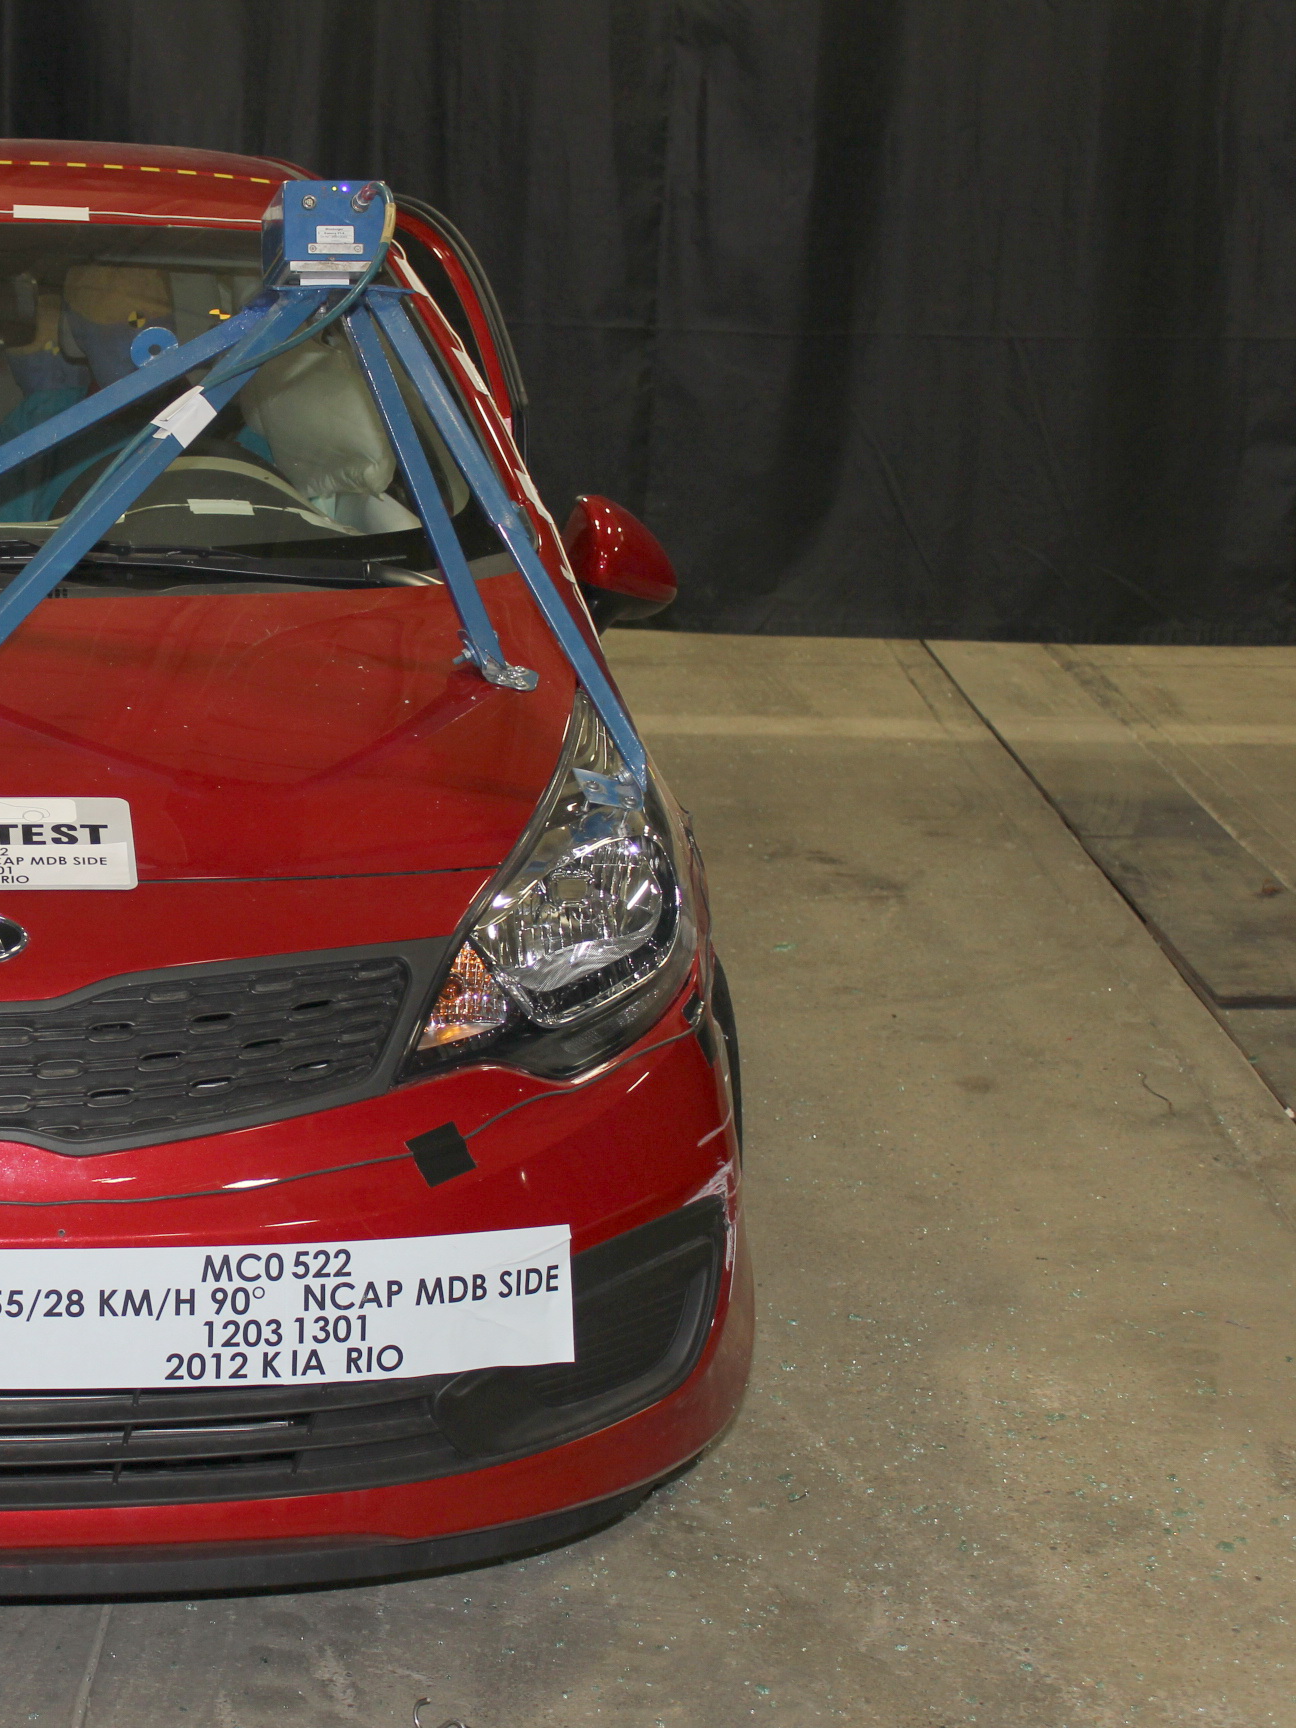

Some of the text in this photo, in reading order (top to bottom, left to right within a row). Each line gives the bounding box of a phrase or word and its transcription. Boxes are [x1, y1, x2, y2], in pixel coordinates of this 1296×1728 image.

[30, 856, 68, 866] MDB
[73, 856, 108, 866] SIDE
[1, 875, 30, 884] RIO
[99, 1288, 196, 1321] KM/H
[210, 1286, 266, 1316] 90°
[303, 1280, 403, 1312] NCAP
[415, 1273, 489, 1306] MDB
[498, 1264, 559, 1299] SIDE
[164, 1351, 248, 1381] 2012
[346, 1344, 404, 1374] RIO
